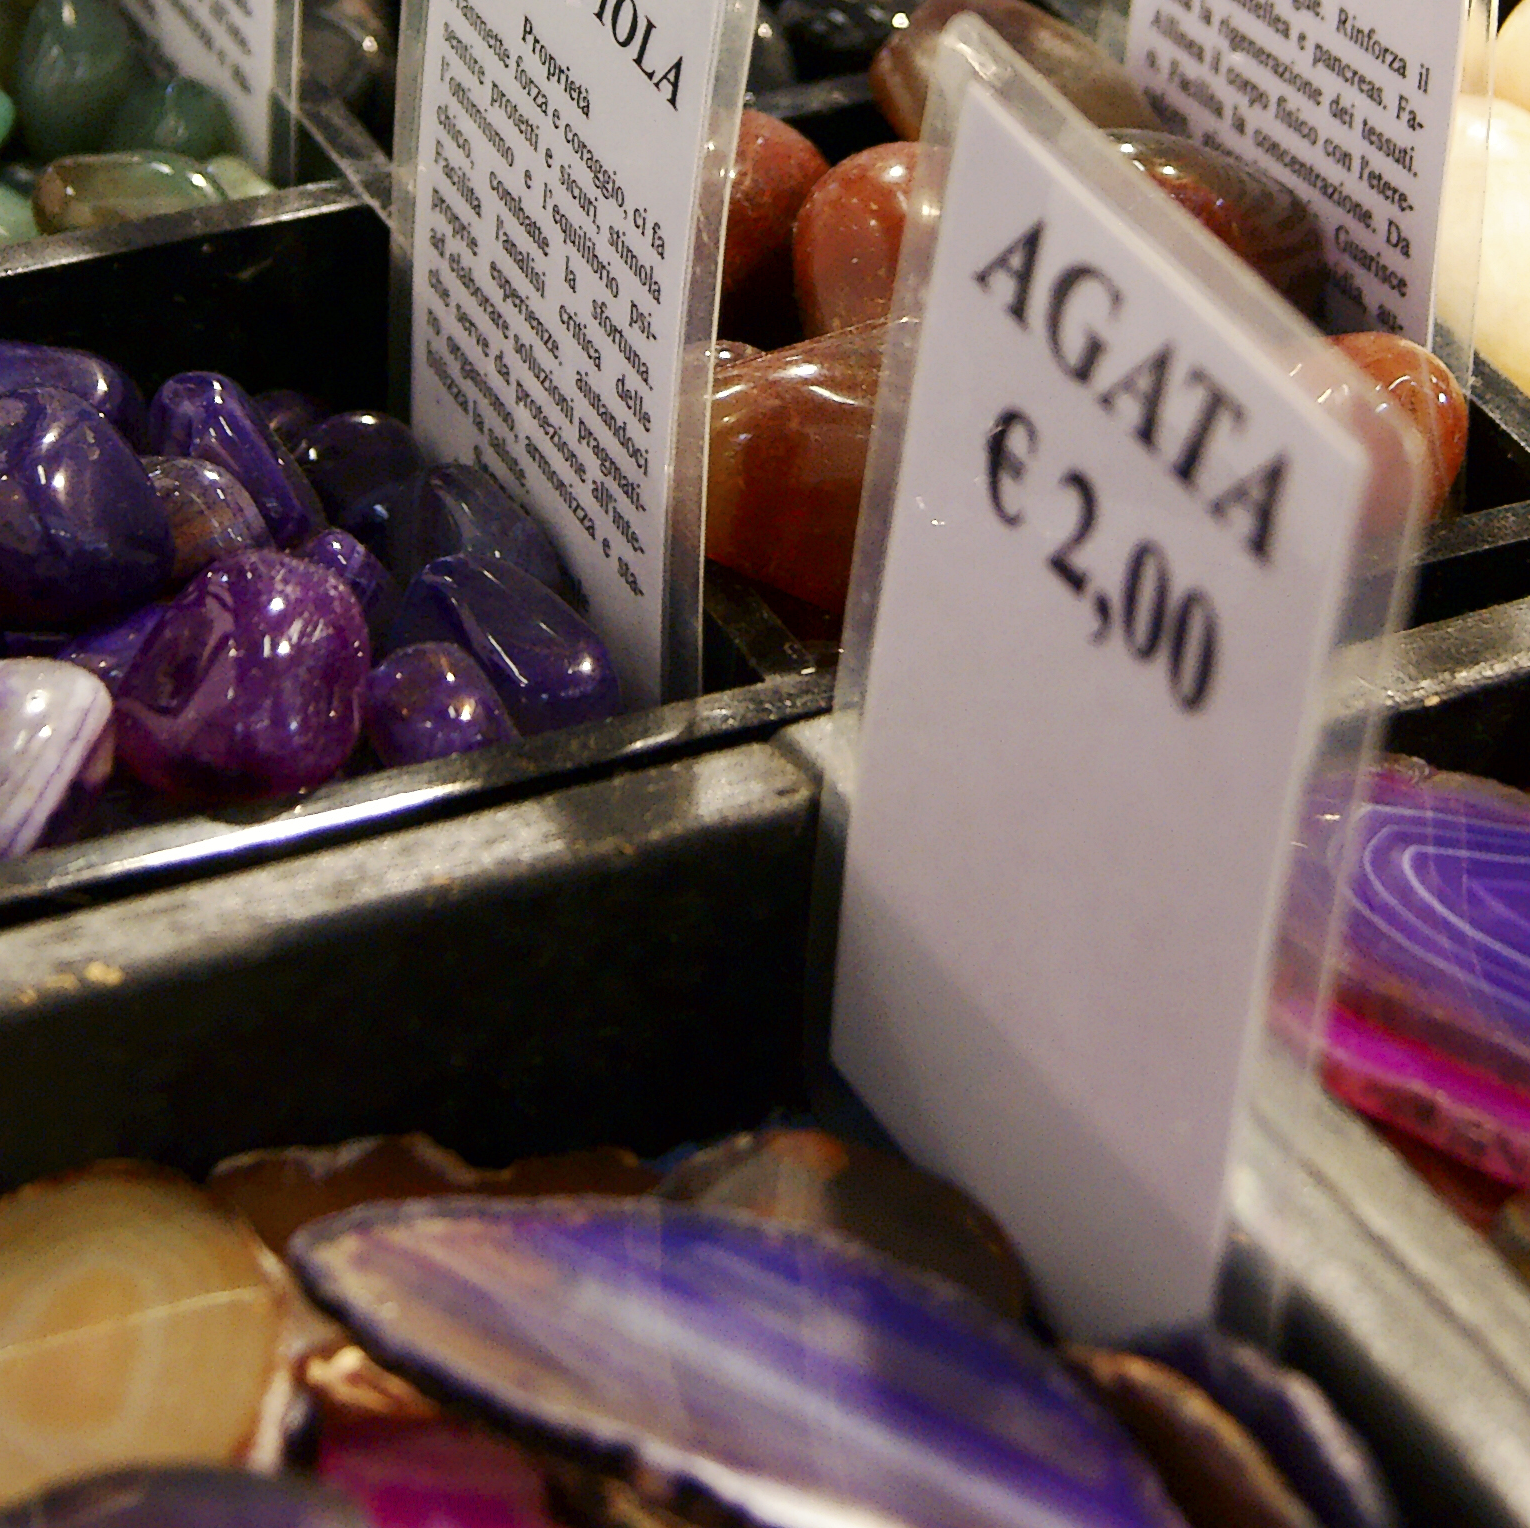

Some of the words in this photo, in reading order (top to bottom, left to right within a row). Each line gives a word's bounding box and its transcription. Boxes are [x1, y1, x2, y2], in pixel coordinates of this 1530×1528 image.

[520, 13, 591, 120] Proprietà
[1216, 14, 1324, 108] rigenerazione
[1327, 91, 1356, 130] dei
[1360, 116, 1418, 179] tessuti.
[1224, 65, 1271, 111] corpo
[1273, 93, 1319, 148] fisico
[1322, 136, 1353, 173] con
[1295, 30, 1307, 52] e
[1310, 41, 1388, 111] pancreas.
[1394, 92, 1425, 133] Fa-
[1334, 5, 1408, 80] Rinforza
[1416, 62, 1431, 95] il
[435, 102, 475, 171] chico,
[487, 169, 550, 258] combatte
[562, 253, 577, 295] la
[589, 297, 654, 392] sfortuna.
[441, 20, 486, 86] sentire
[488, 78, 540, 154] protetti
[543, 146, 554, 170] e
[557, 162, 601, 236] sicuri,
[606, 223, 662, 306] stimola
[513, 53, 549, 118] forza
[550, 107, 561, 130] e
[562, 121, 628, 221] coraggio,
[631, 206, 648, 238] ci
[649, 220, 666, 261] fa
[522, 167, 533, 191] e
[627, 298, 658, 342] psi-
[1229, 104, 1247, 138] la
[1383, 216, 1411, 260] Da
[426, 267, 451, 309] che
[453, 301, 490, 359] serve
[492, 348, 511, 387] da
[513, 377, 587, 485] protezione
[428, 226, 446, 260] ad
[447, 251, 510, 341] elaborare
[511, 331, 575, 426] soluzioni
[576, 415, 648, 514] pragmati-
[429, 185, 479, 258] proprie
[574, 368, 650, 479] aiutandoci
[432, 137, 483, 220] Facilita
[557, 303, 602, 373] critica
[614, 372, 652, 434] delle
[971, 218, 1290, 571] AGATA
[523, 433, 597, 542] armonizza
[600, 536, 612, 559] e
[616, 554, 645, 598] sta-
[984, 406, 1038, 528] €
[1045, 467, 1221, 716] 2,00
